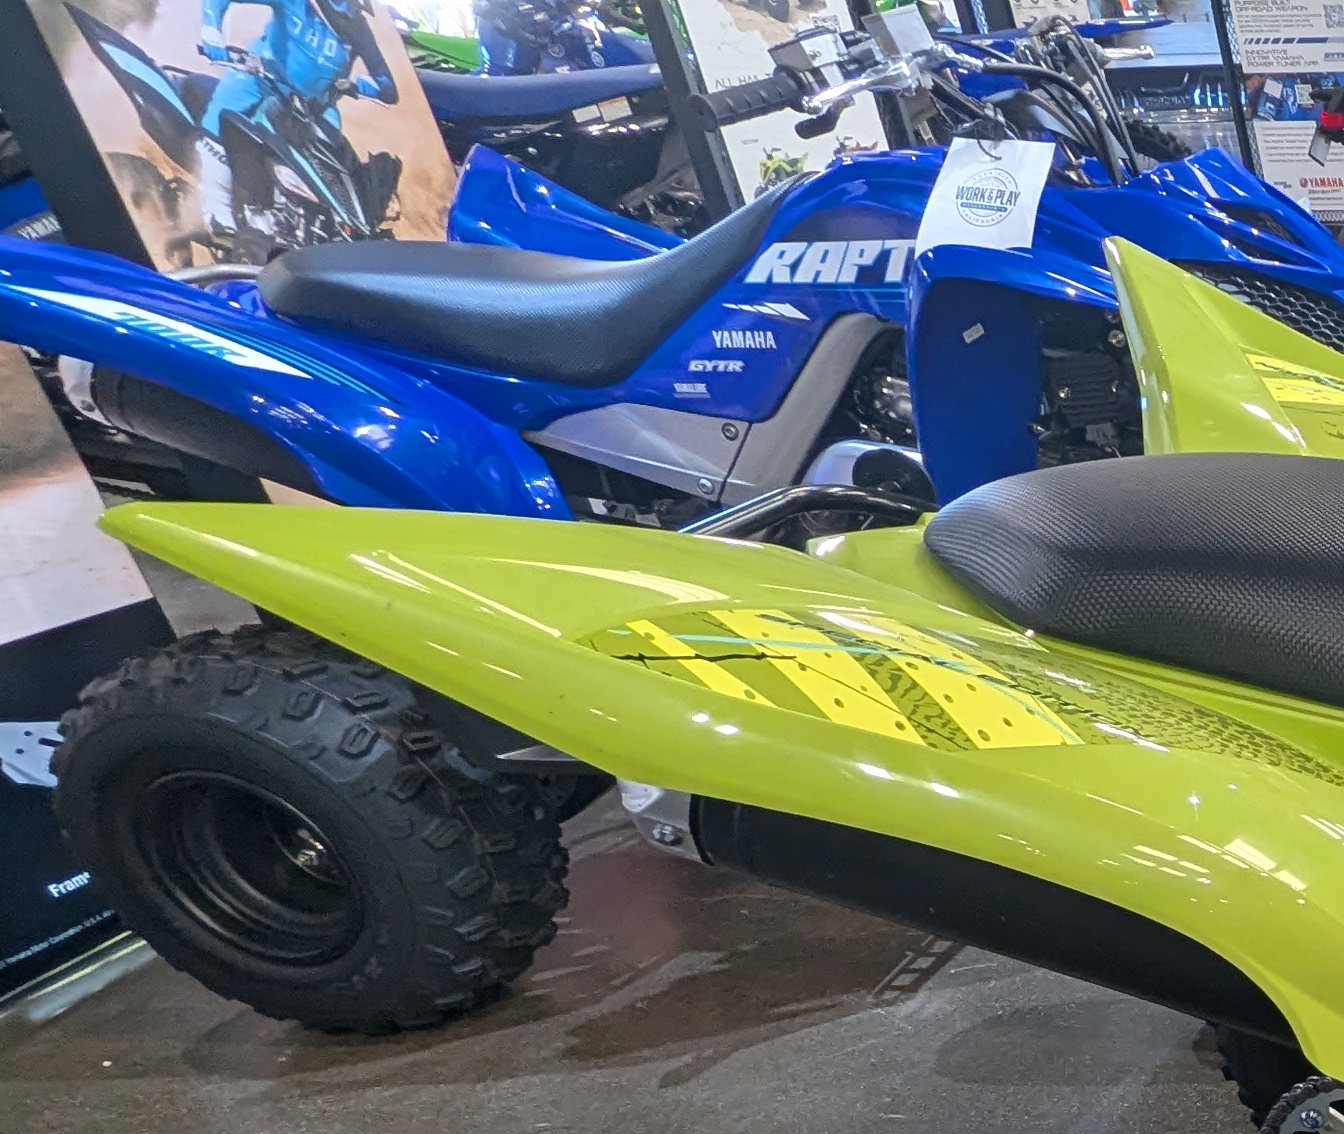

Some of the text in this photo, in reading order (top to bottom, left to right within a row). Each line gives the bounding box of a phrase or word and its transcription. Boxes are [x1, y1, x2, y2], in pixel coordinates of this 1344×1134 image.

[1309, 178, 1344, 188] YAMAHA
[743, 239, 916, 284] RAPT
[712, 330, 777, 349] YAMAHA
[688, 360, 745, 372] GYTR
